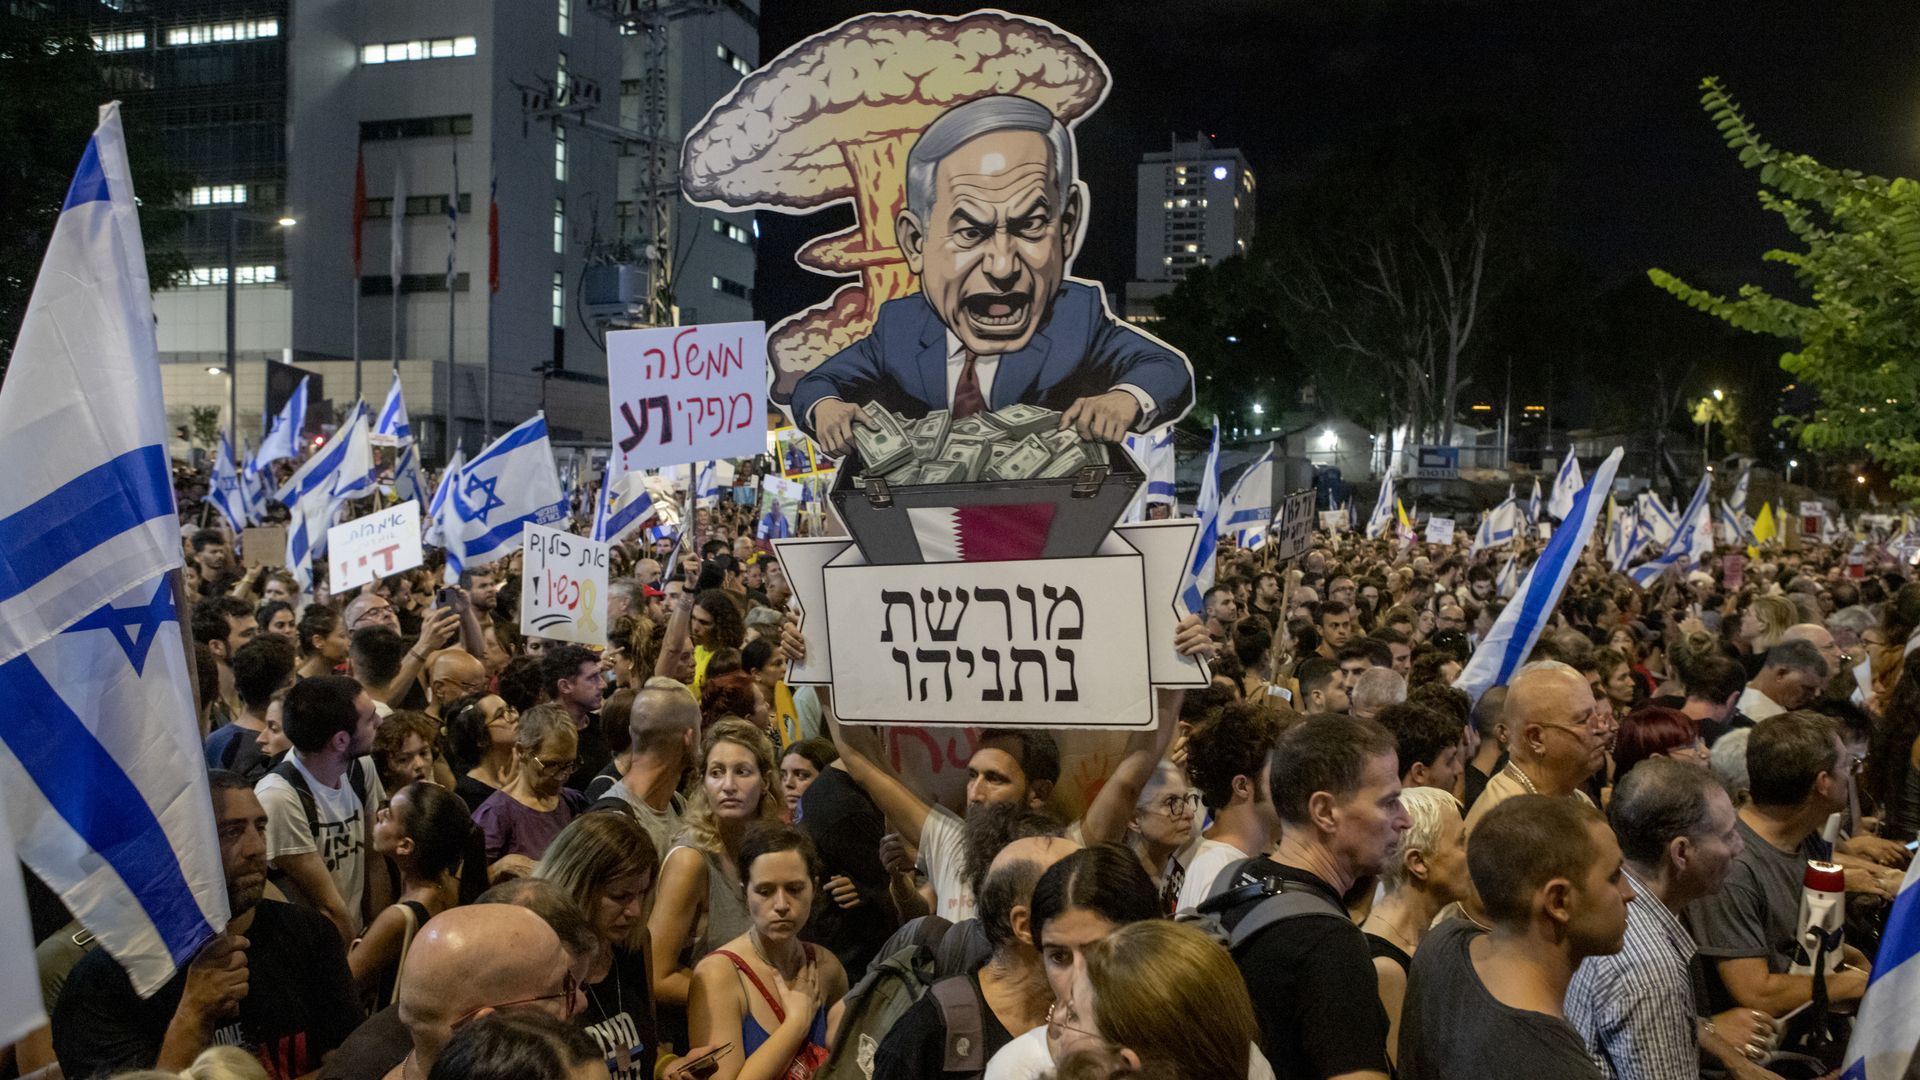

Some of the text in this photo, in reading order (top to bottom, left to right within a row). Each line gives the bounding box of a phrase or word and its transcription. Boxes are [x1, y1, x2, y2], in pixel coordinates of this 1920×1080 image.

[642, 327, 743, 380] ממשלה
[578, 547, 605, 568] את
[880, 583, 1085, 643] מורשת
[891, 645, 1079, 703] נתניהו
[212, 1022, 246, 1046] OME
